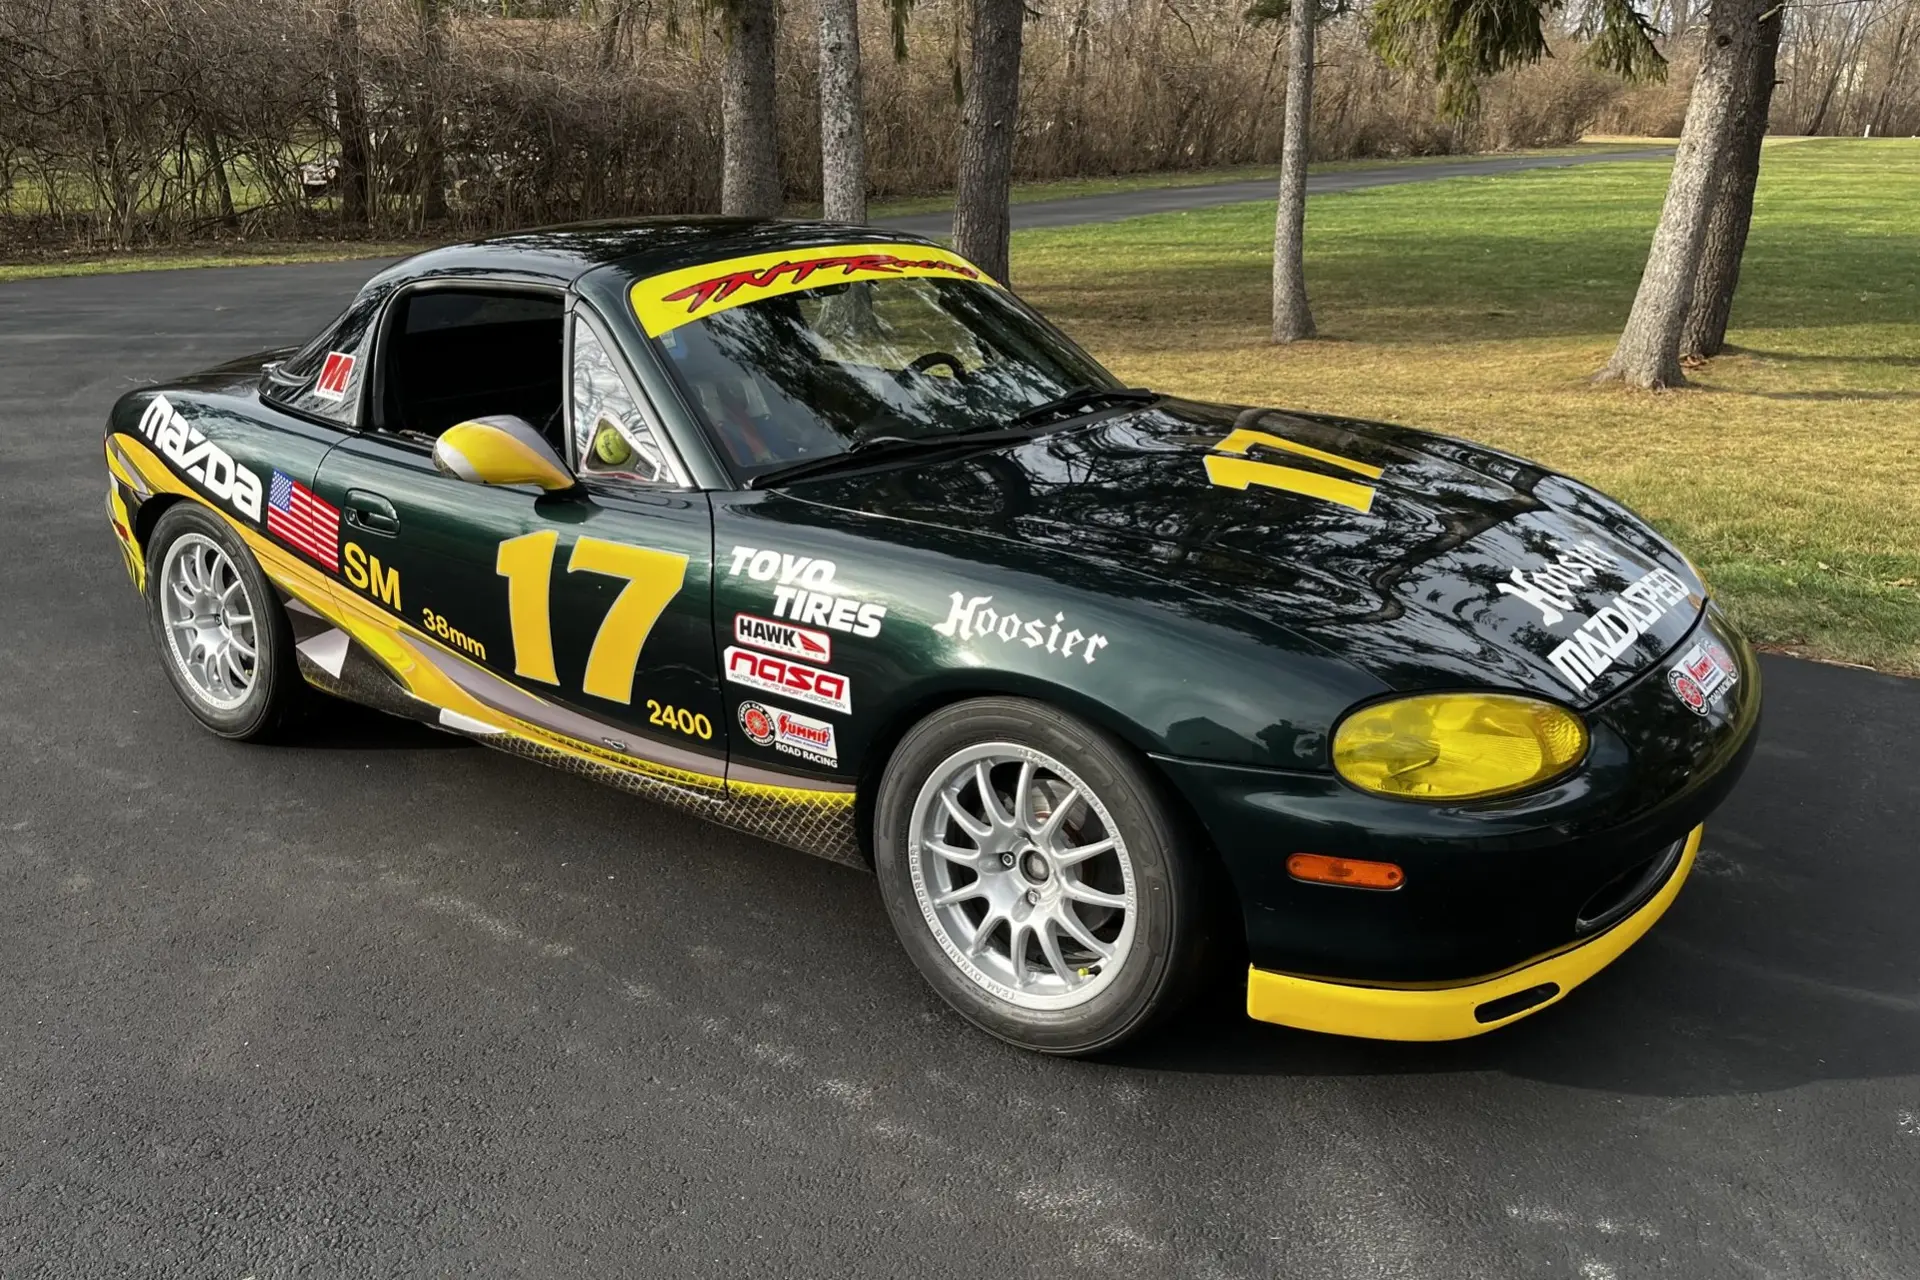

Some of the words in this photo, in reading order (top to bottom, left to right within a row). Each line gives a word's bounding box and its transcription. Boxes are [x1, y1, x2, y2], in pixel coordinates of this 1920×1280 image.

[138, 395, 263, 522] mazda
[344, 542, 401, 610] SM
[729, 545, 837, 587] TOYO
[423, 608, 487, 660] 38mm
[496, 530, 690, 705] 17
[739, 618, 796, 648] HAWK
[772, 585, 887, 638] TIRES
[933, 591, 1109, 664] Hoosier
[1547, 568, 1691, 691] MAZDASPEED
[730, 651, 845, 700] nasa
[762, 682, 781, 691] AUTO
[646, 700, 713, 740] 2400
[775, 742, 801, 757] ROAD
[802, 750, 838, 768] RACING
